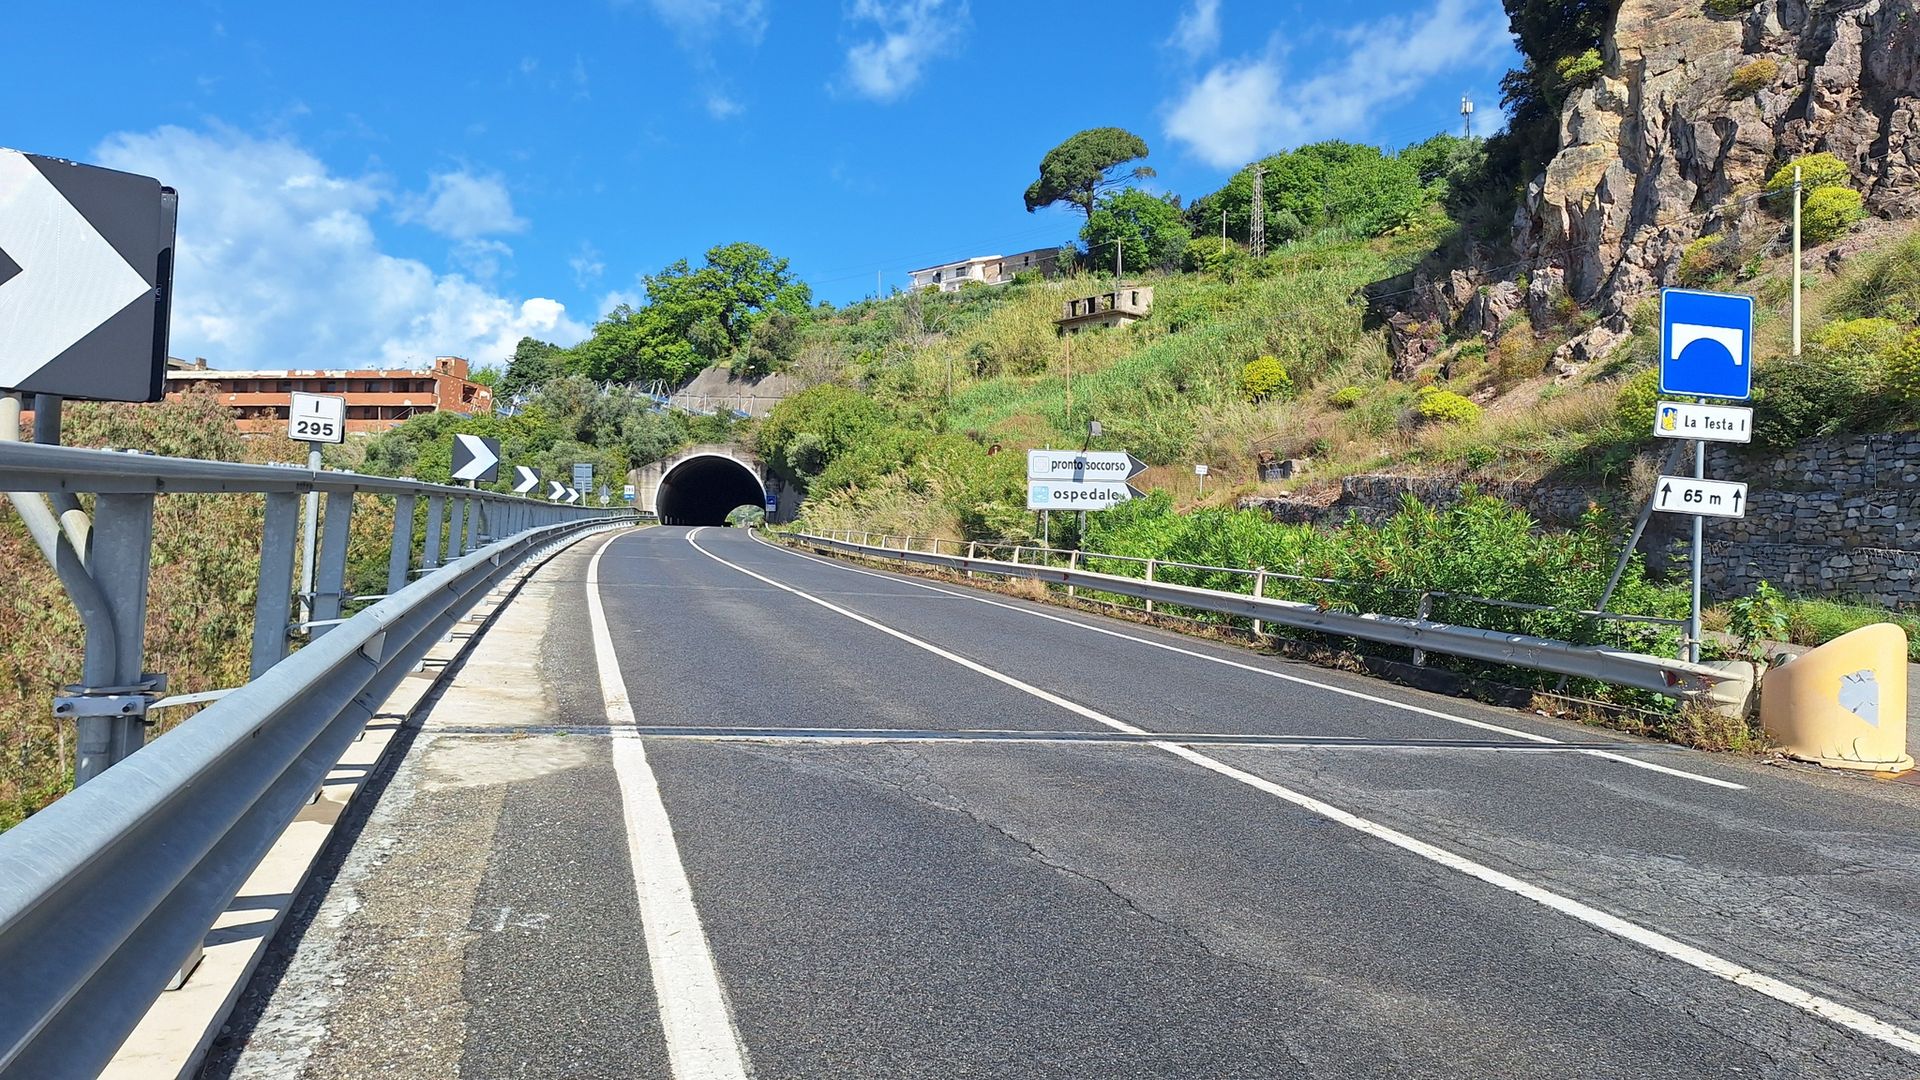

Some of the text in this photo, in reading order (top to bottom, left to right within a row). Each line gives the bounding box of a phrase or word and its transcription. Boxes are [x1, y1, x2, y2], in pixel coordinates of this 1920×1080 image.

[297, 420, 333, 436] 295
[1684, 415, 1697, 428] La
[1704, 416, 1734, 431] Testa
[1051, 459, 1126, 472] pronto soccorso
[1053, 488, 1119, 502] ospedale
[1683, 488, 1721, 505] 65 m
